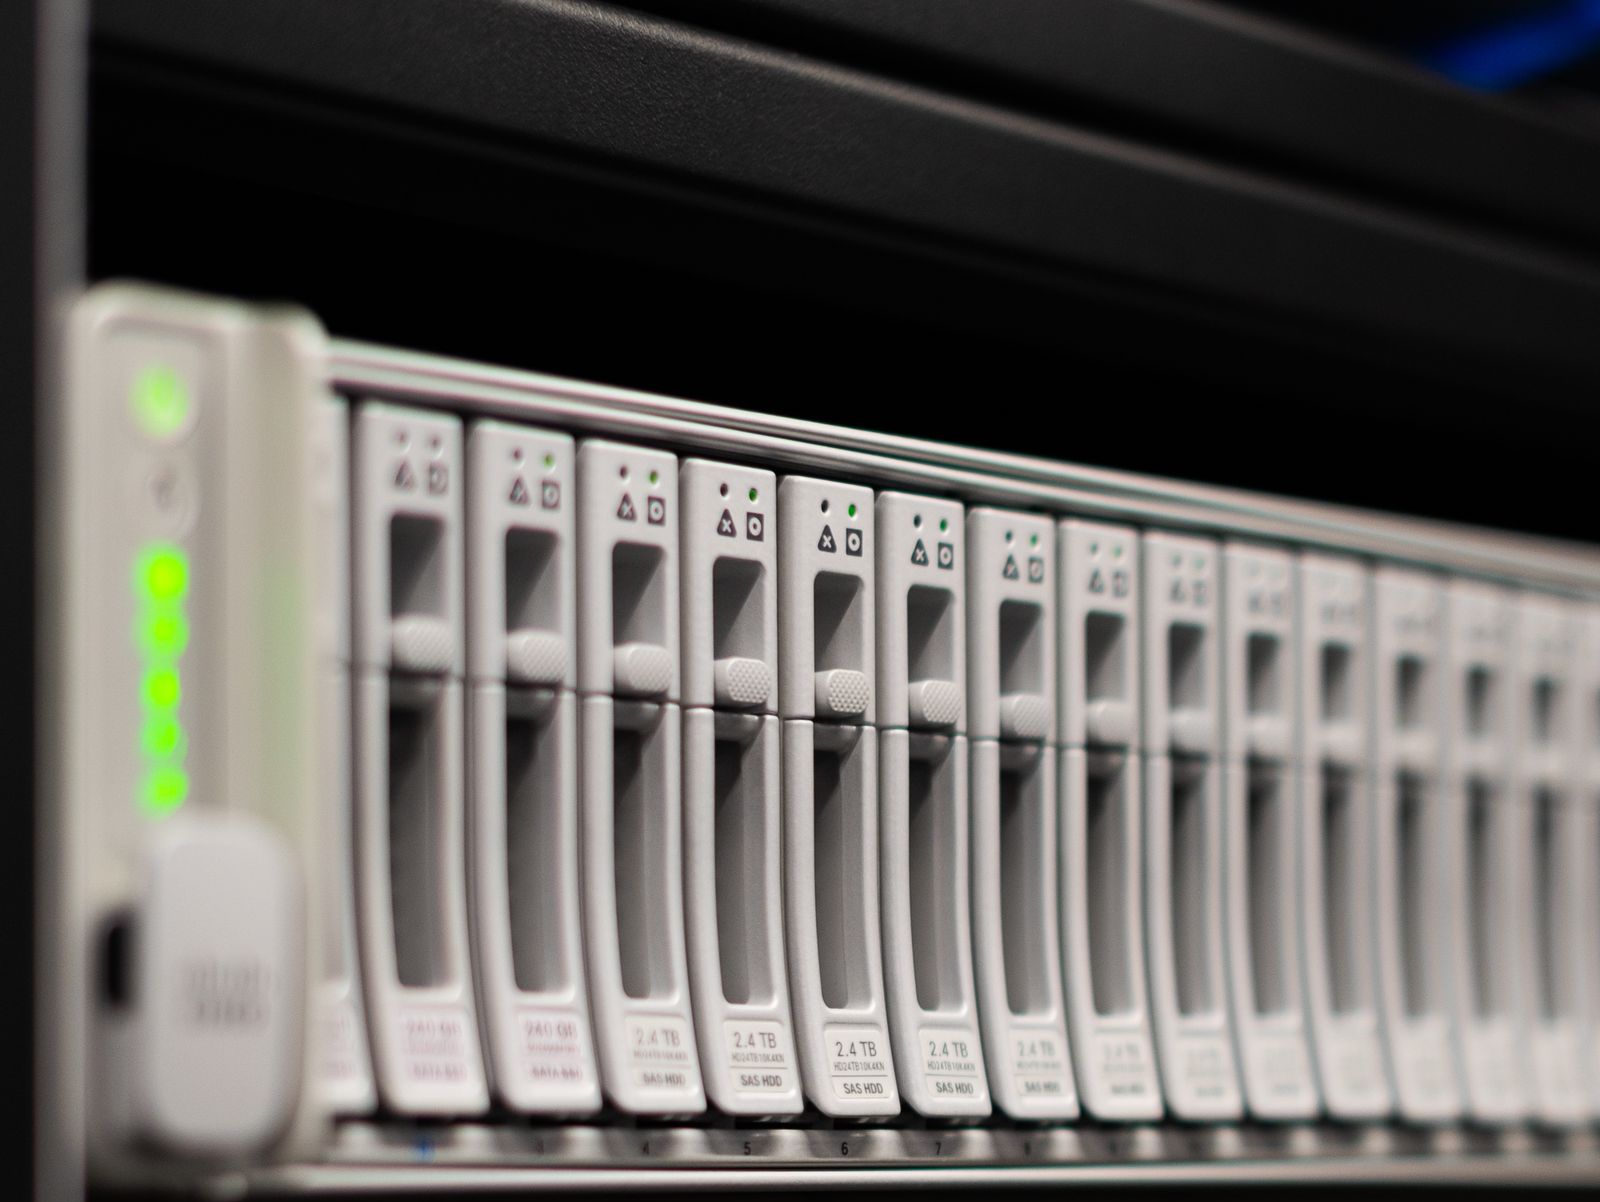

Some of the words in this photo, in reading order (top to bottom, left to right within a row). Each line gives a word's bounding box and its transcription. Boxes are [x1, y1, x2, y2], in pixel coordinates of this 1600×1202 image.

[636, 1027, 658, 1046] 2.4
[661, 1028, 681, 1047] TB
[734, 1031, 756, 1049] 2.4
[758, 1031, 777, 1049] TB
[835, 1041, 857, 1057] 2.4
[860, 1041, 877, 1057] TB
[929, 1041, 949, 1057] 2.4
[952, 1041, 969, 1058] TB
[1016, 1040, 1037, 1057] 2.4
[1039, 1040, 1055, 1057] TB
[833, 1060, 885, 1072] HD24TB10K4KN
[643, 1071, 662, 1085] SAS
[665, 1072, 687, 1086] HDD
[740, 1074, 760, 1087] SAS
[762, 1074, 783, 1087] HDD
[843, 1082, 862, 1095] SAS
[864, 1082, 884, 1095] HDD
[935, 1081, 953, 1094] SAS
[956, 1082, 974, 1095] HDD
[643, 1141, 650, 1156] 4
[744, 1141, 751, 1156] 5
[841, 1141, 849, 1156] 6
[935, 1141, 942, 1156] 7
